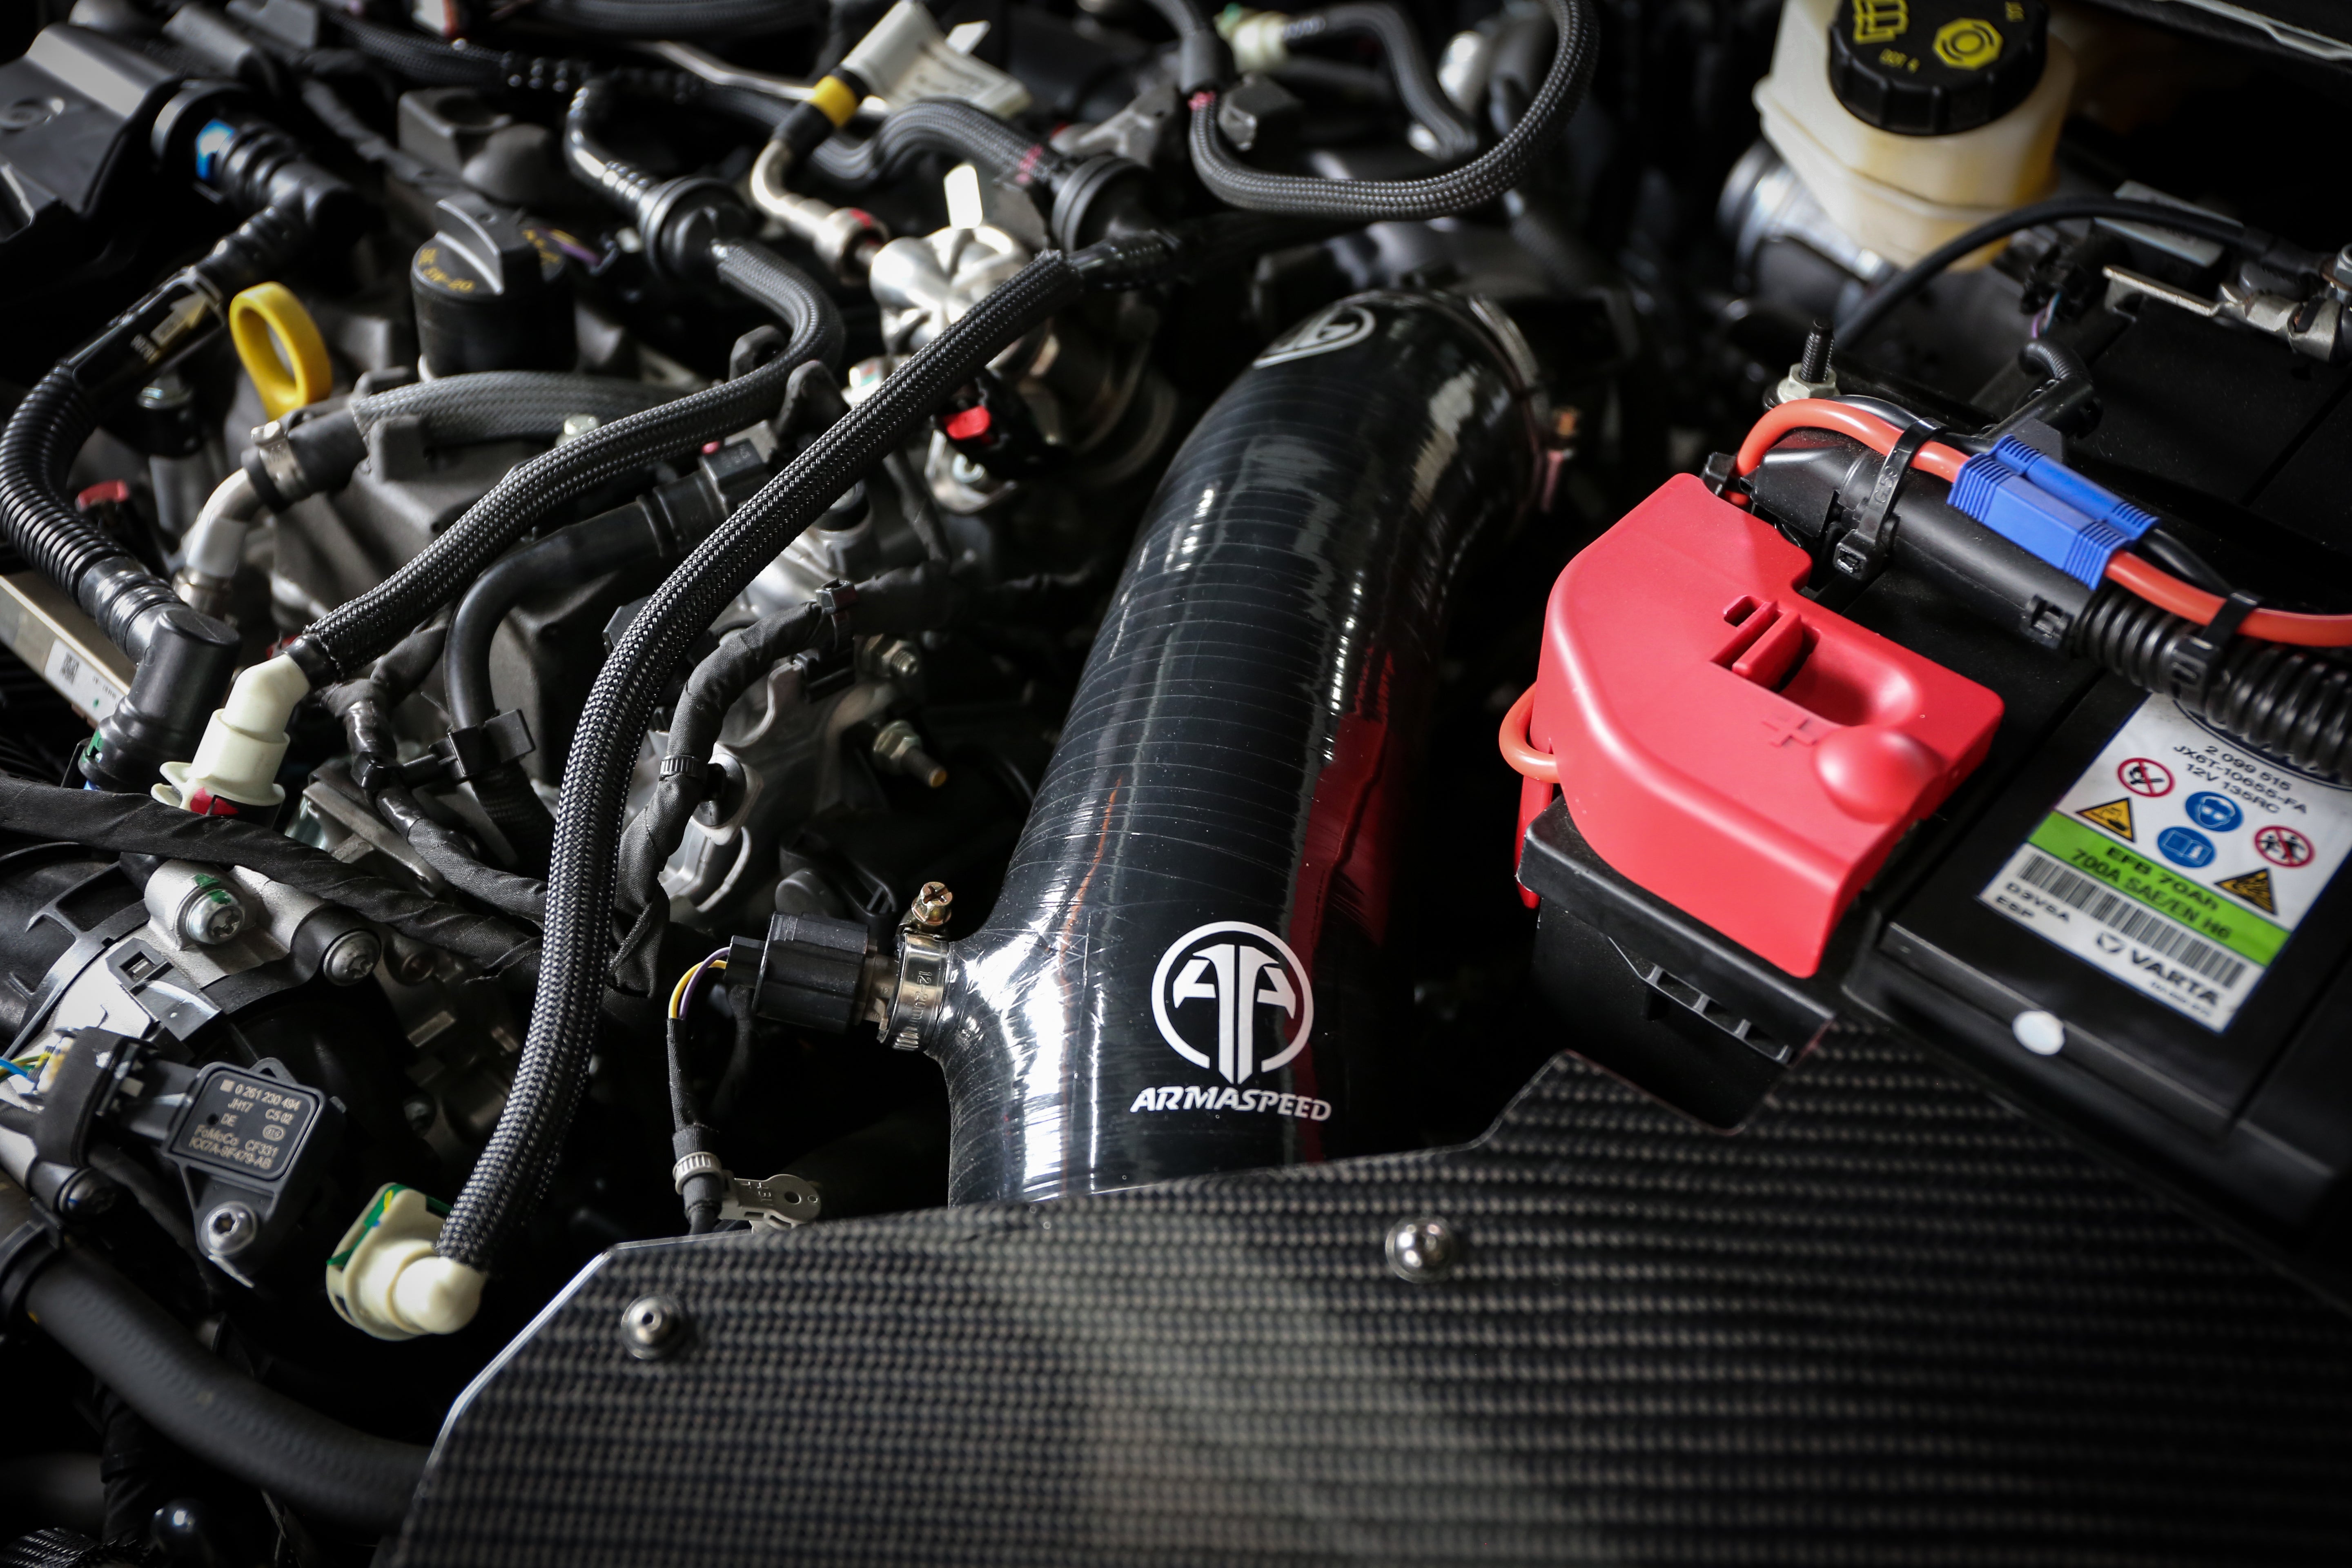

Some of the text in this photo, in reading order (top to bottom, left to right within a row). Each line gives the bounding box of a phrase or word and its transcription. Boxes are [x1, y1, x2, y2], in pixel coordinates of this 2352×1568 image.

[2205, 746, 2218, 755] 2
[2222, 753, 2257, 773] 099
[2173, 745, 2306, 814] JX6T-10655-FA
[2187, 763, 2280, 813] 12V 135RC
[2073, 848, 2121, 882] 700A
[2125, 877, 2200, 922] SAE/EN
[2106, 847, 2218, 911] EFB 70Ah
[2131, 949, 2218, 1006] VARTA
[227, 1098, 255, 1113] JH17
[235, 1083, 302, 1111] 0 261 230 494
[1129, 1085, 1332, 1122] ARMASPEED
[220, 1112, 239, 1127] DE
[194, 1124, 279, 1158] FoMoCo CF331
